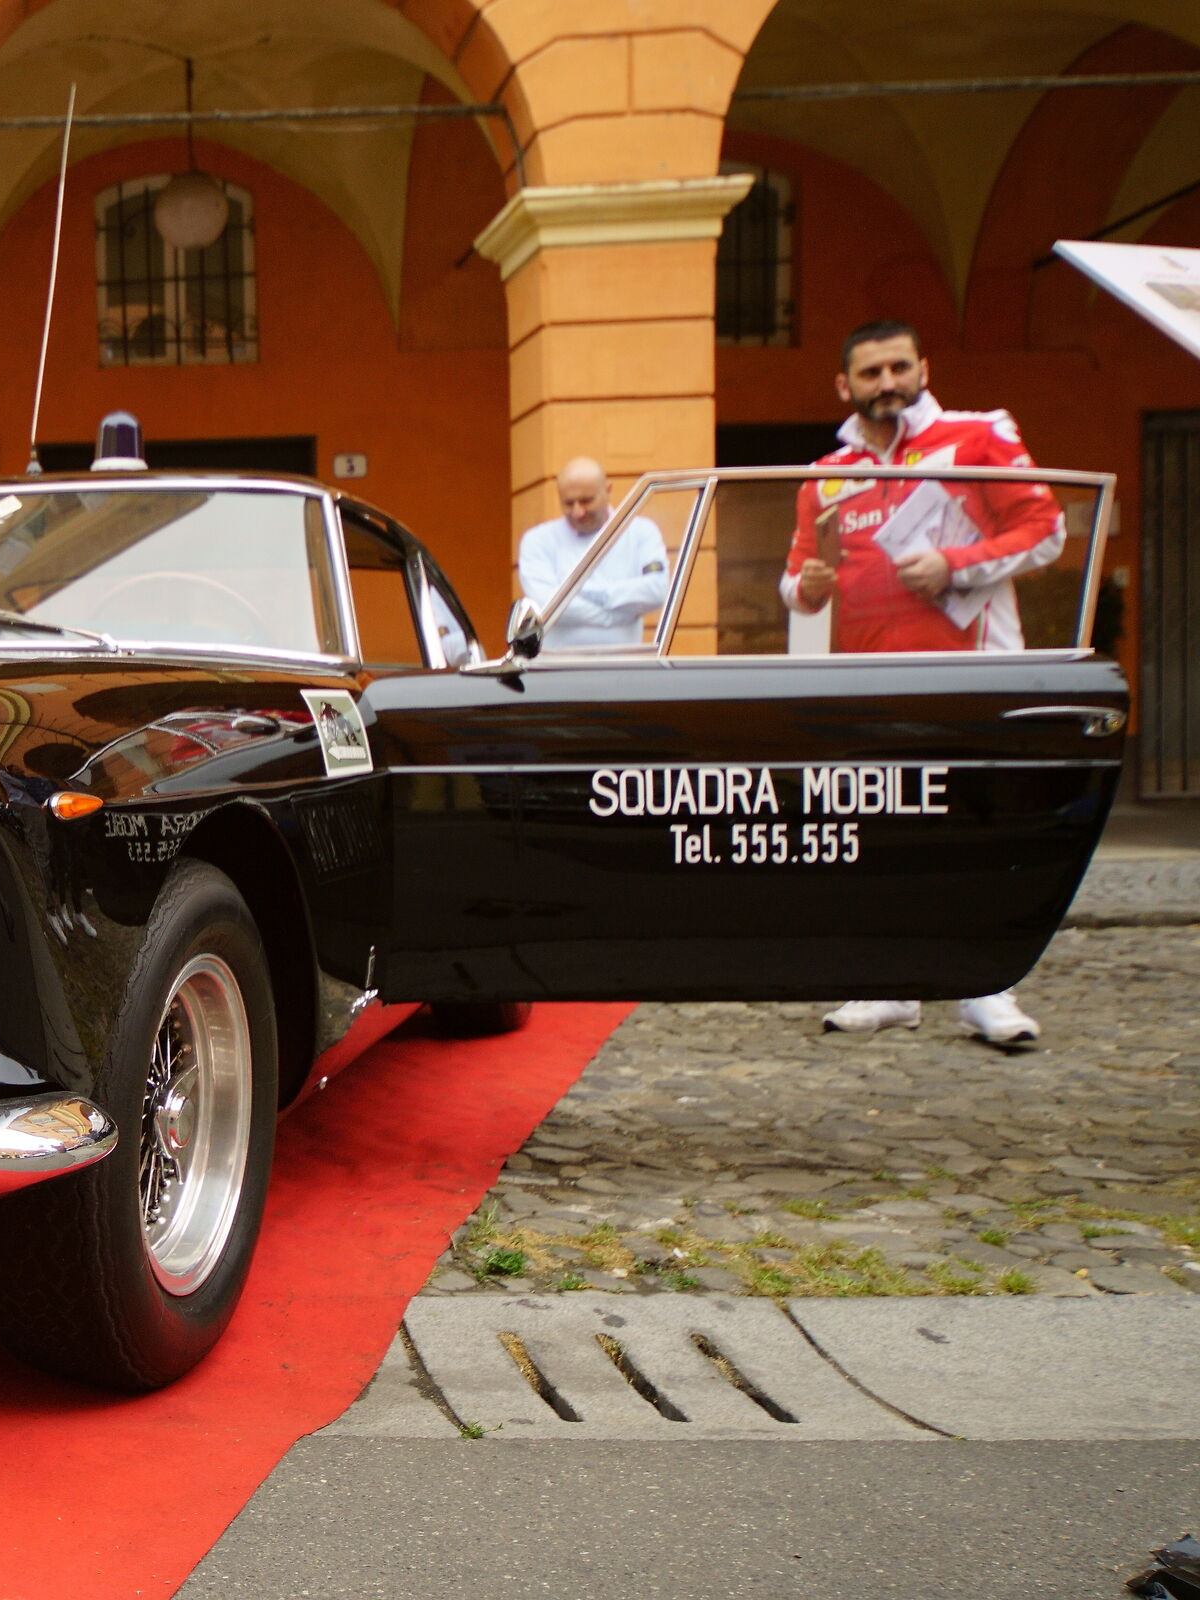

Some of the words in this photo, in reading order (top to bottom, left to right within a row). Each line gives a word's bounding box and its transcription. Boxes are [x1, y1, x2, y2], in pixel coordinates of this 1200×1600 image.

[589, 768, 779, 816] SQUADRA
[803, 766, 949, 815] MOBILE
[670, 823, 721, 864] Tel.
[731, 822, 859, 864] 555.555
